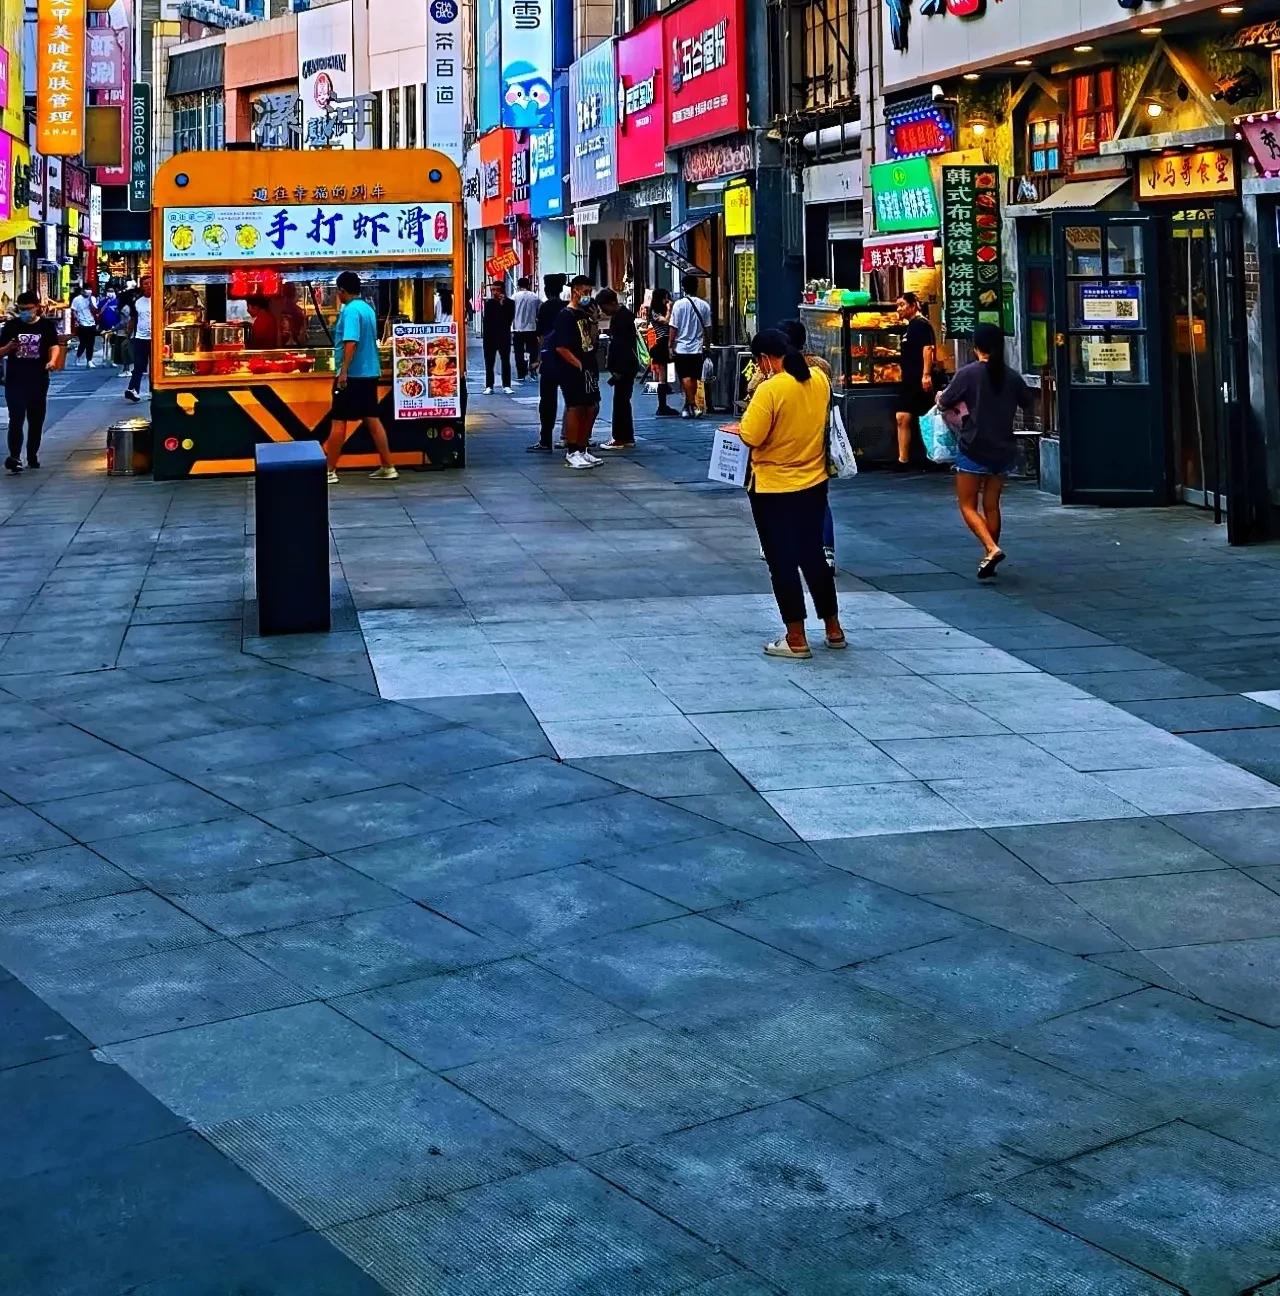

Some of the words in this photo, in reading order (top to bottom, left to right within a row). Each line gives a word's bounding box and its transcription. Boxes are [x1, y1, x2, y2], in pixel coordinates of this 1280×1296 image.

[435, 31, 454, 104] 茶百道
[1147, 154, 1229, 190] 小马哥食堂
[265, 205, 432, 250] 手打虾滑
